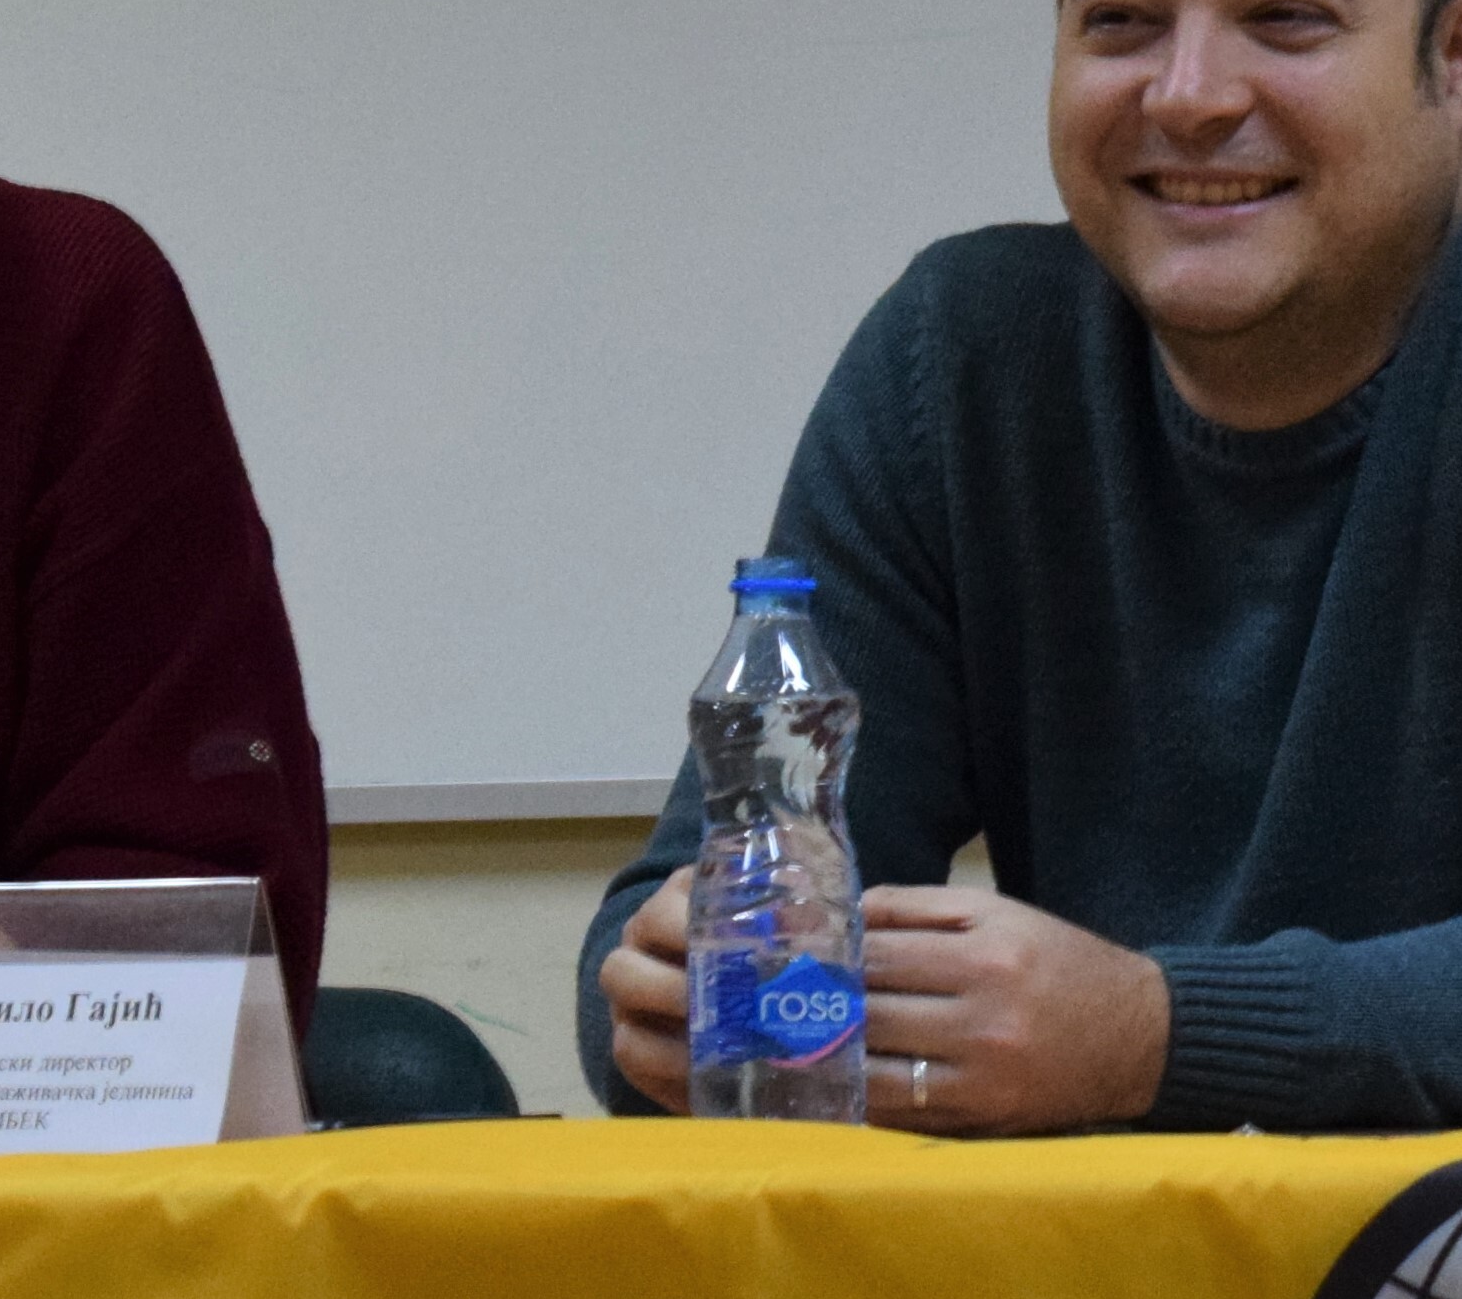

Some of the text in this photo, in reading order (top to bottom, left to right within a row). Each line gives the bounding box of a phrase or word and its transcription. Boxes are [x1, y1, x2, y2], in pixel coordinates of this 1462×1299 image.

[66, 991, 163, 1029] Гајић
[759, 990, 850, 1022] rosa
[38, 1054, 134, 1076] директор
